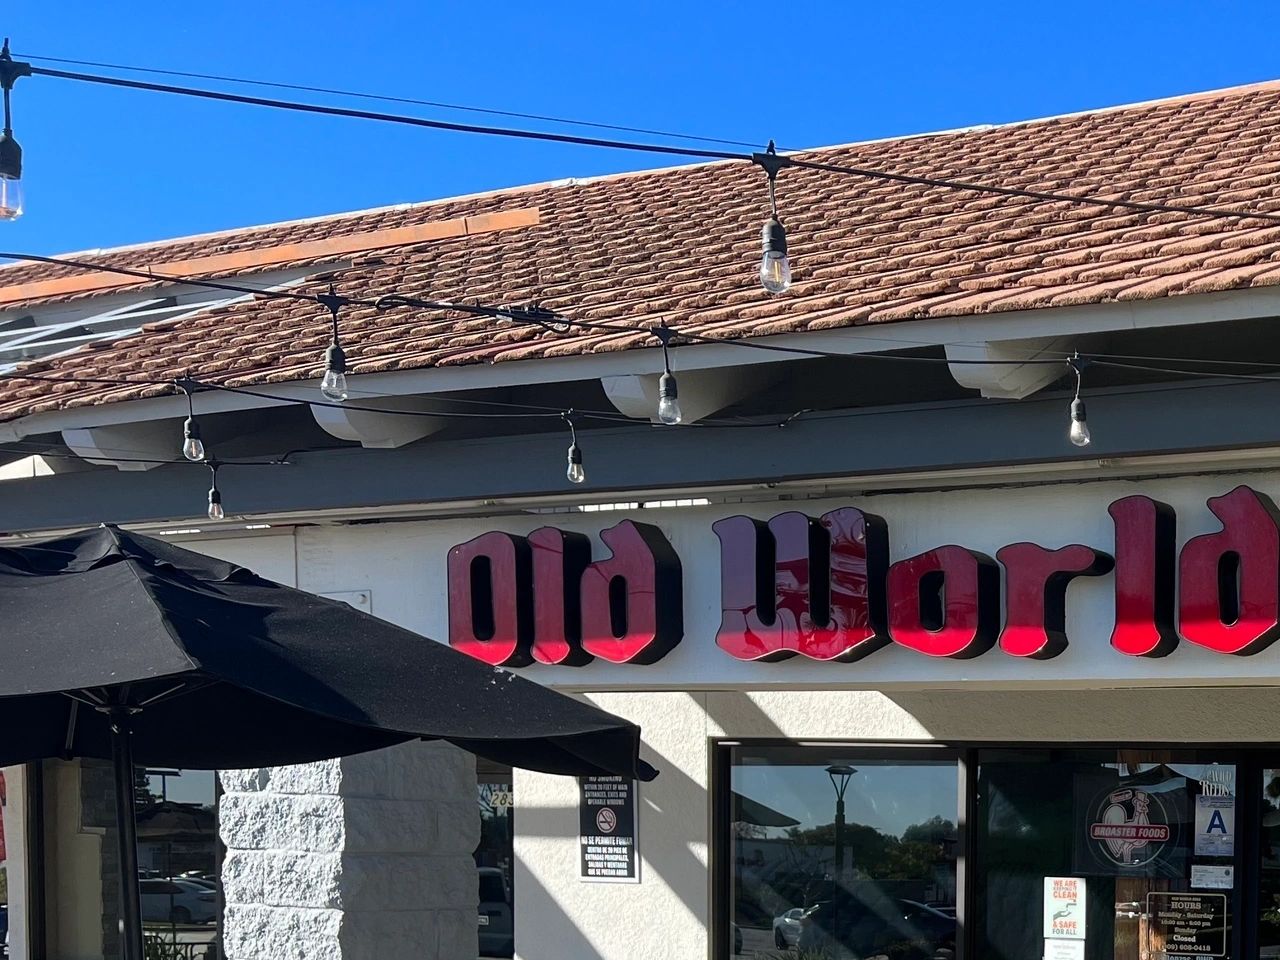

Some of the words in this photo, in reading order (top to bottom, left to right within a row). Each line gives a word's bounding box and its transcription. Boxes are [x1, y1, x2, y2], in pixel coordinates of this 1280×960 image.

[447, 518, 680, 667] Old
[1094, 826, 1137, 836] BROASTER
[1137, 828, 1167, 838] FOODS
[1206, 809, 1227, 834] A
